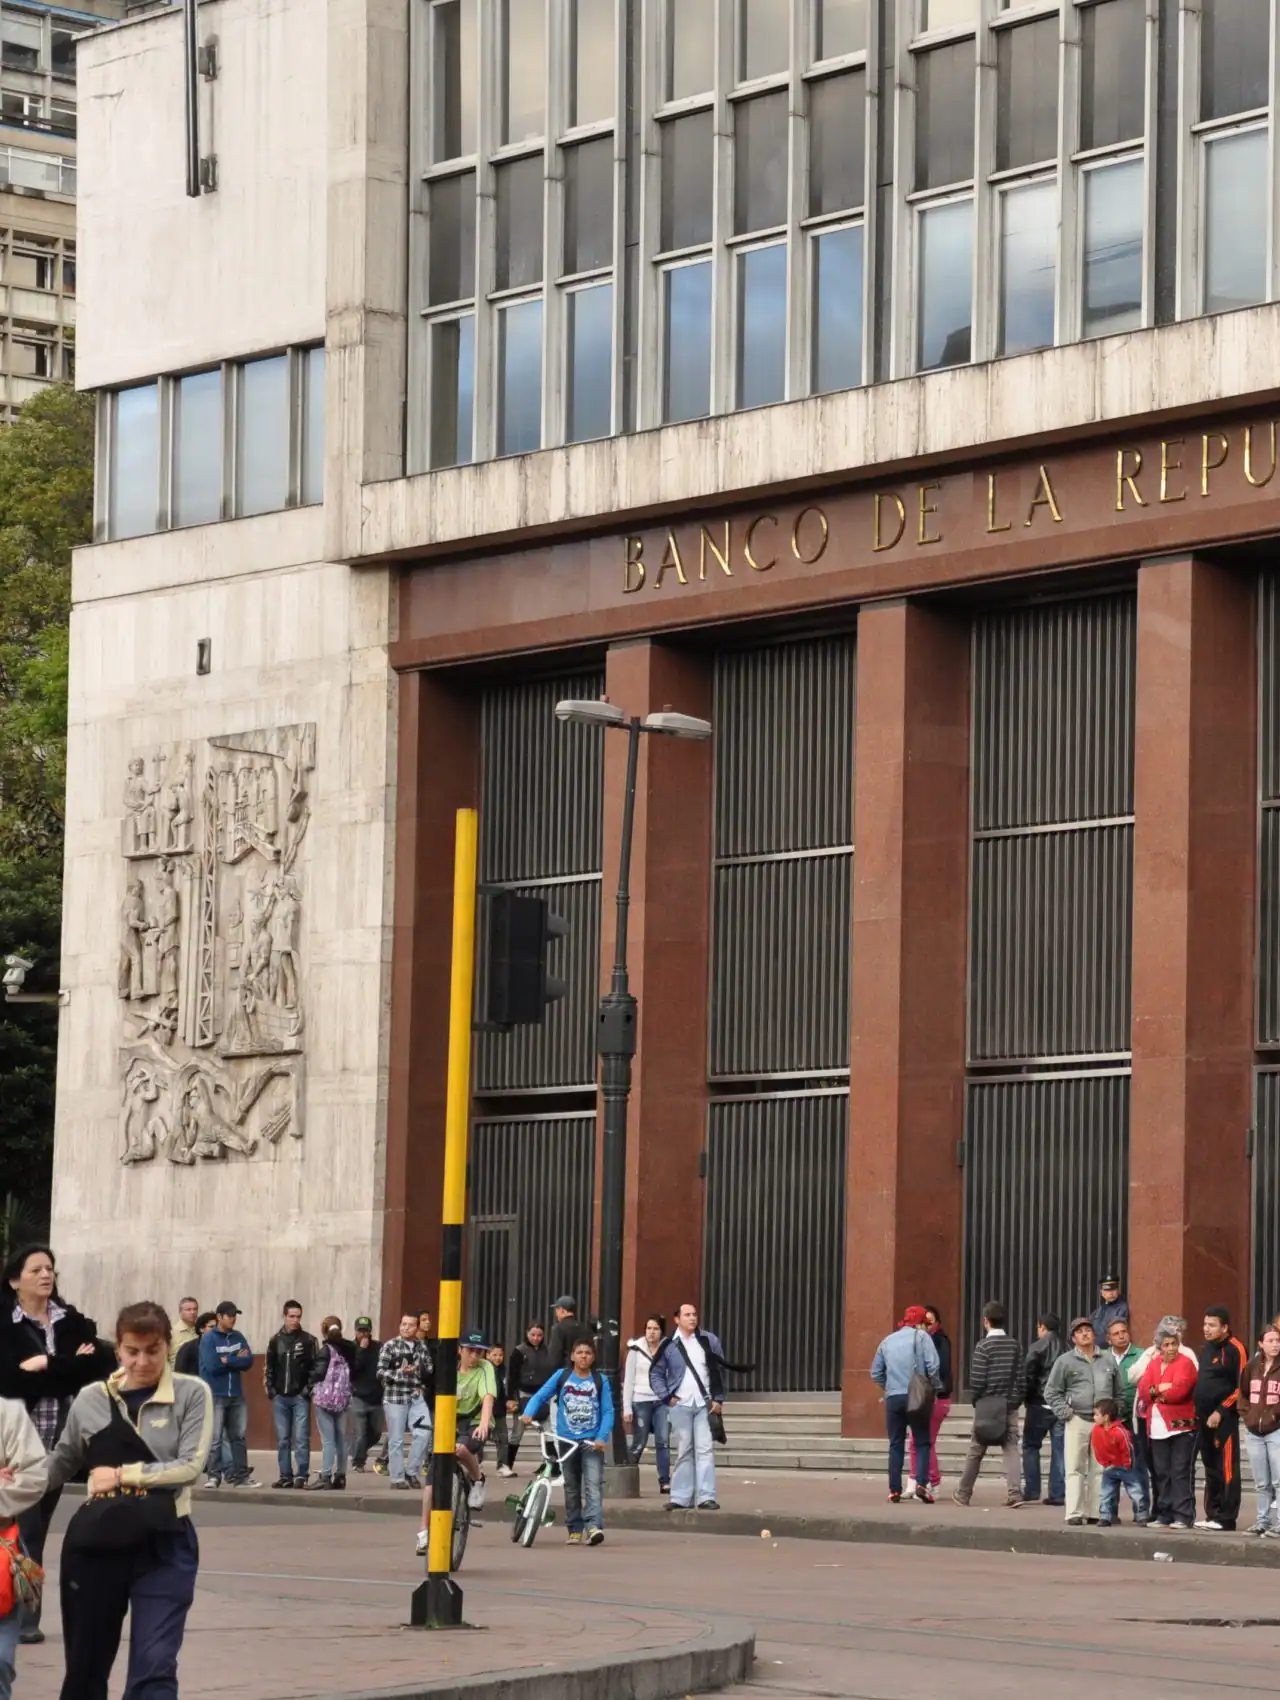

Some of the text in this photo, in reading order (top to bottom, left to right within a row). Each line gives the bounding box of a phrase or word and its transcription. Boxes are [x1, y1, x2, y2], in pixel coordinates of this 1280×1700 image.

[622, 506, 829, 594] BANCO
[872, 483, 942, 553] DE
[986, 464, 1064, 534] LA
